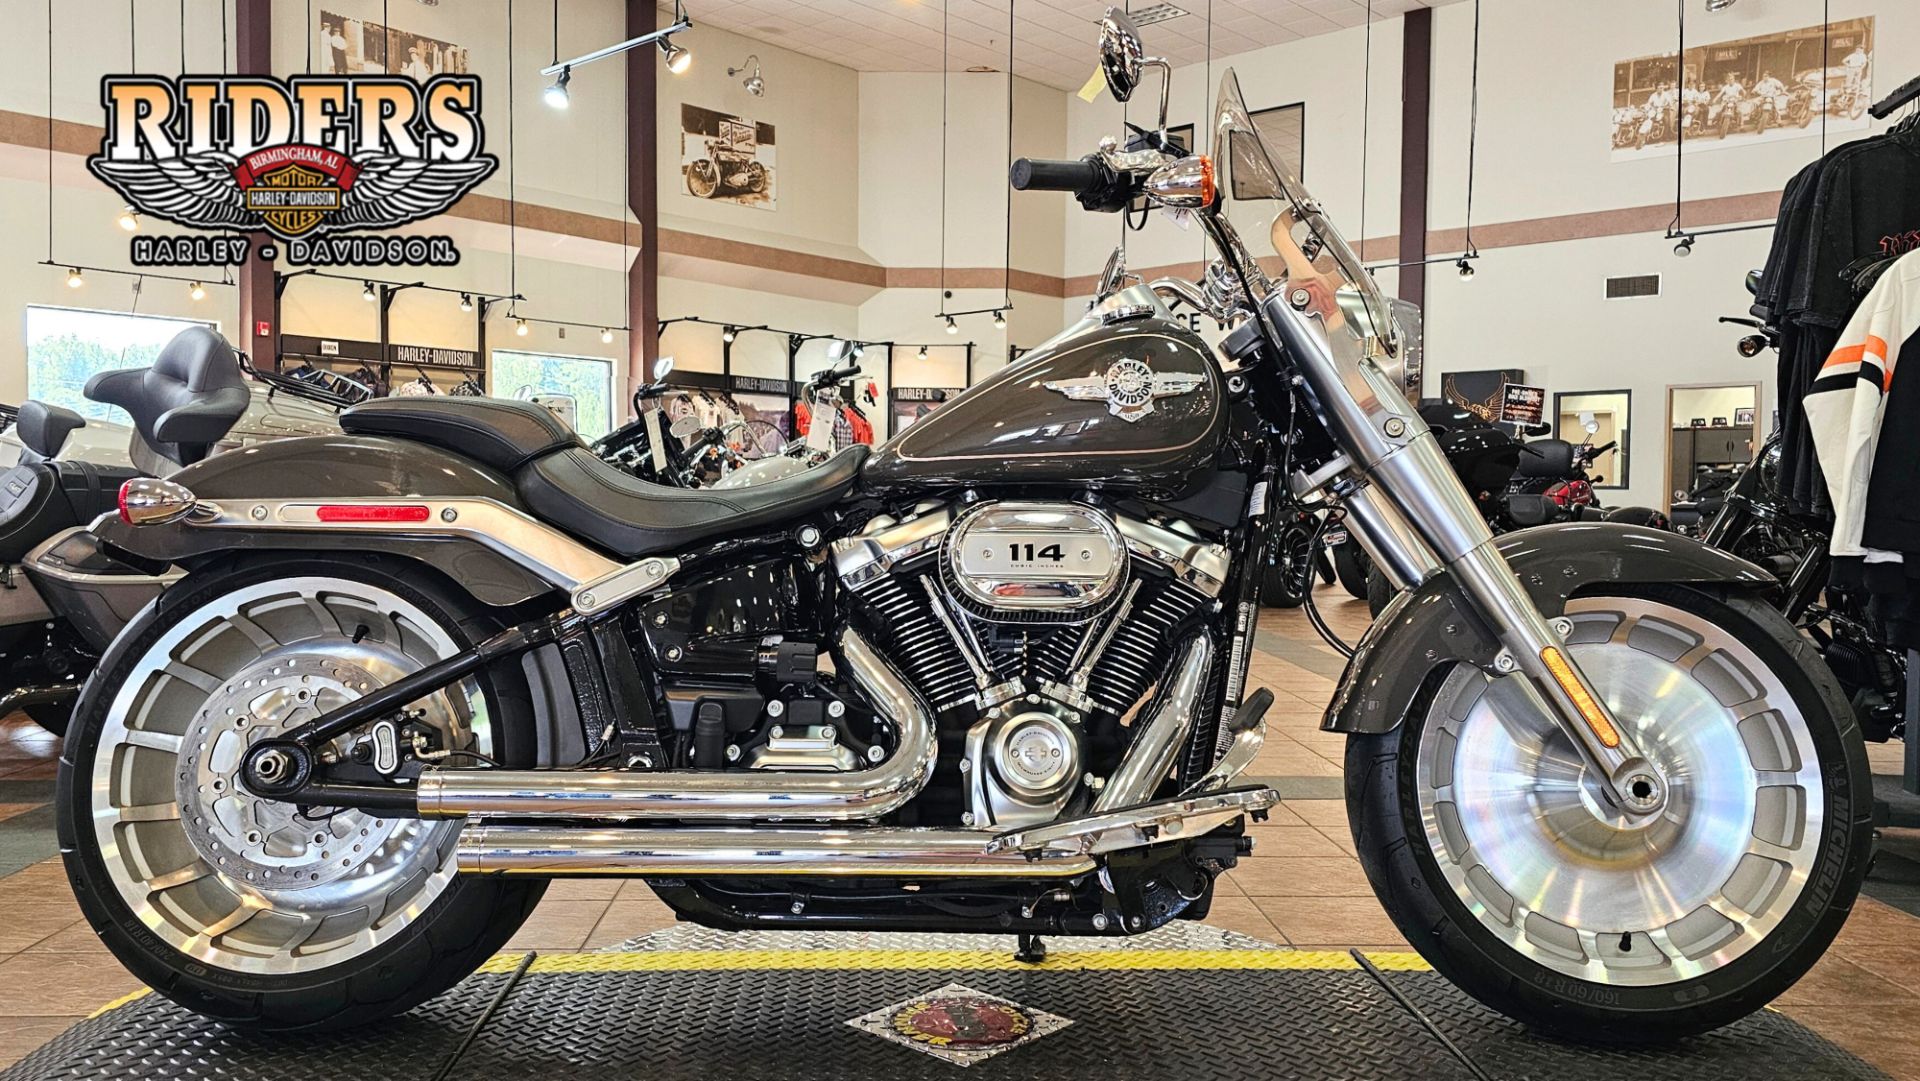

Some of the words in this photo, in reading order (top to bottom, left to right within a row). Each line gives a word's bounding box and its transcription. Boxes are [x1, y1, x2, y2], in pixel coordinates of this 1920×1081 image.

[397, 346, 475, 367] HARLEY-DAVIDSON
[735, 376, 788, 393] HARLEY-DAVIDSON
[1109, 381, 1153, 404] DAVIDSON
[1009, 543, 1066, 562] 114
[1806, 797, 1849, 918] MICHELIN
